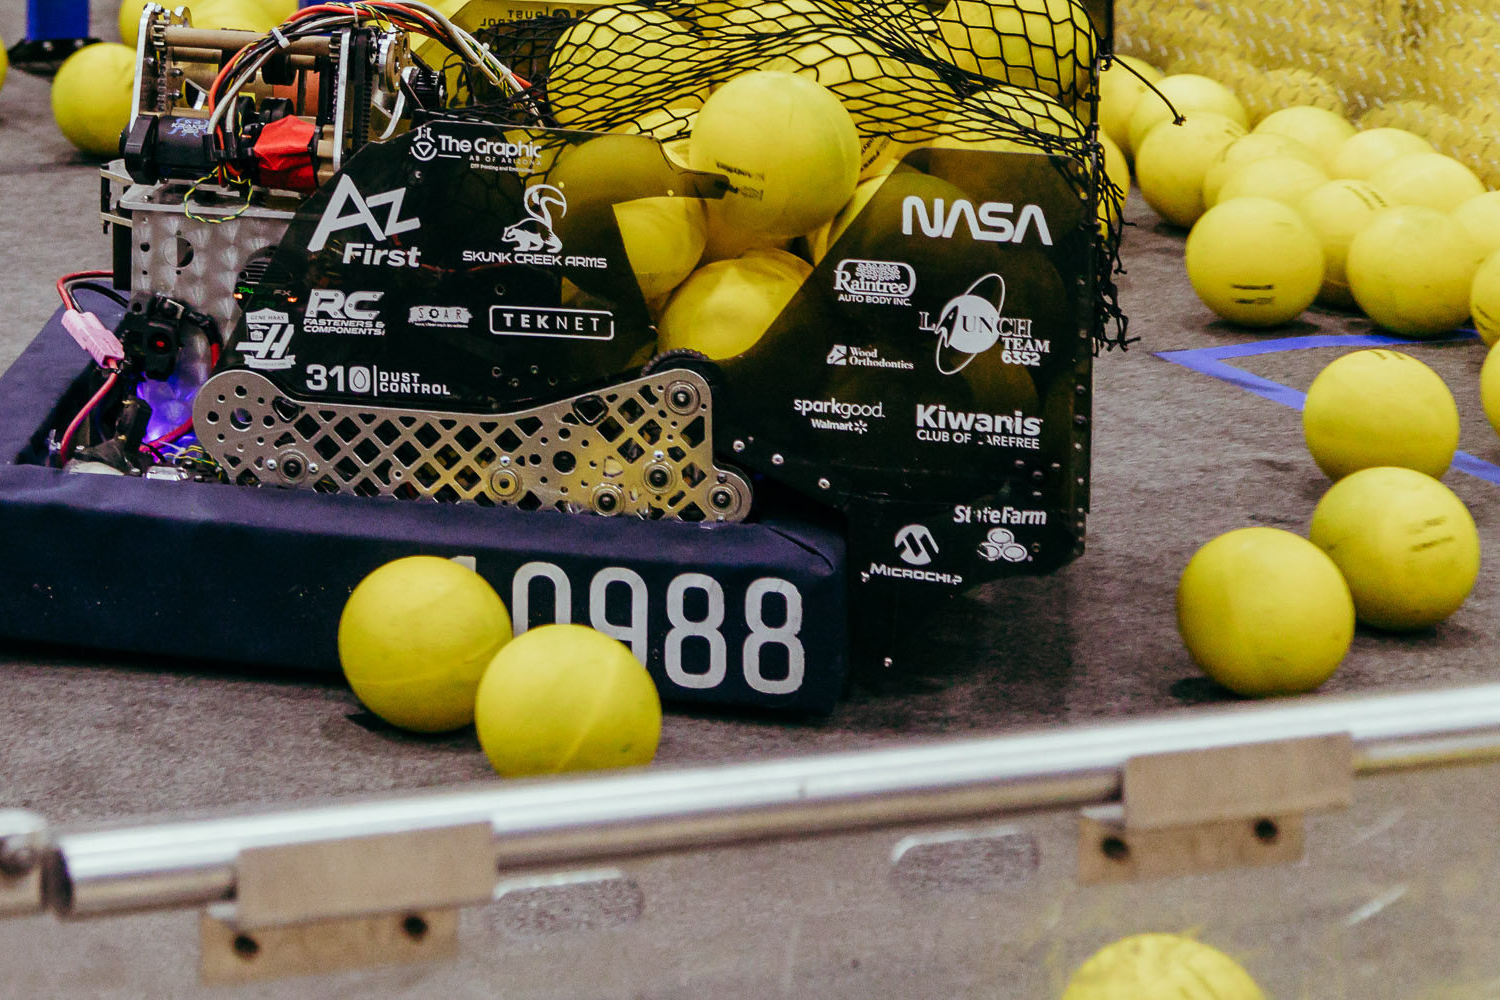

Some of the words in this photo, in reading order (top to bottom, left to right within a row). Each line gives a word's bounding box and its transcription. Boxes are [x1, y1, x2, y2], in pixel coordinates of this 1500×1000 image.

[438, 134, 472, 153] The
[474, 137, 542, 159] Graphic
[902, 195, 1053, 246] NASA
[342, 242, 421, 268] First
[462, 250, 513, 264] SKUNK
[514, 253, 562, 266] CREEK
[565, 256, 608, 269] ARMS
[833, 269, 909, 294] Raintree
[305, 288, 385, 320] RC
[838, 293, 864, 303] AUTO
[865, 295, 892, 305] BODY
[303, 318, 373, 328] FASTENERS
[375, 321, 386, 329] &
[303, 325, 382, 336] COMPONENTS
[503, 313, 600, 332] TEKNET
[849, 346, 878, 358] Wood
[1001, 336, 1051, 353] TEAM
[848, 356, 915, 370] Orthodontics
[1001, 351, 1041, 367] 6352
[305, 364, 371, 393] 310
[380, 371, 420, 383] DUST
[380, 382, 451, 395] CONTROL
[811, 418, 854, 432] Walmart
[916, 403, 1042, 436] Kiwanis
[916, 429, 950, 443] CLUB
[952, 432, 972, 444] OF
[977, 434, 1041, 450] AREFREE
[450, 555, 805, 695] 0988
